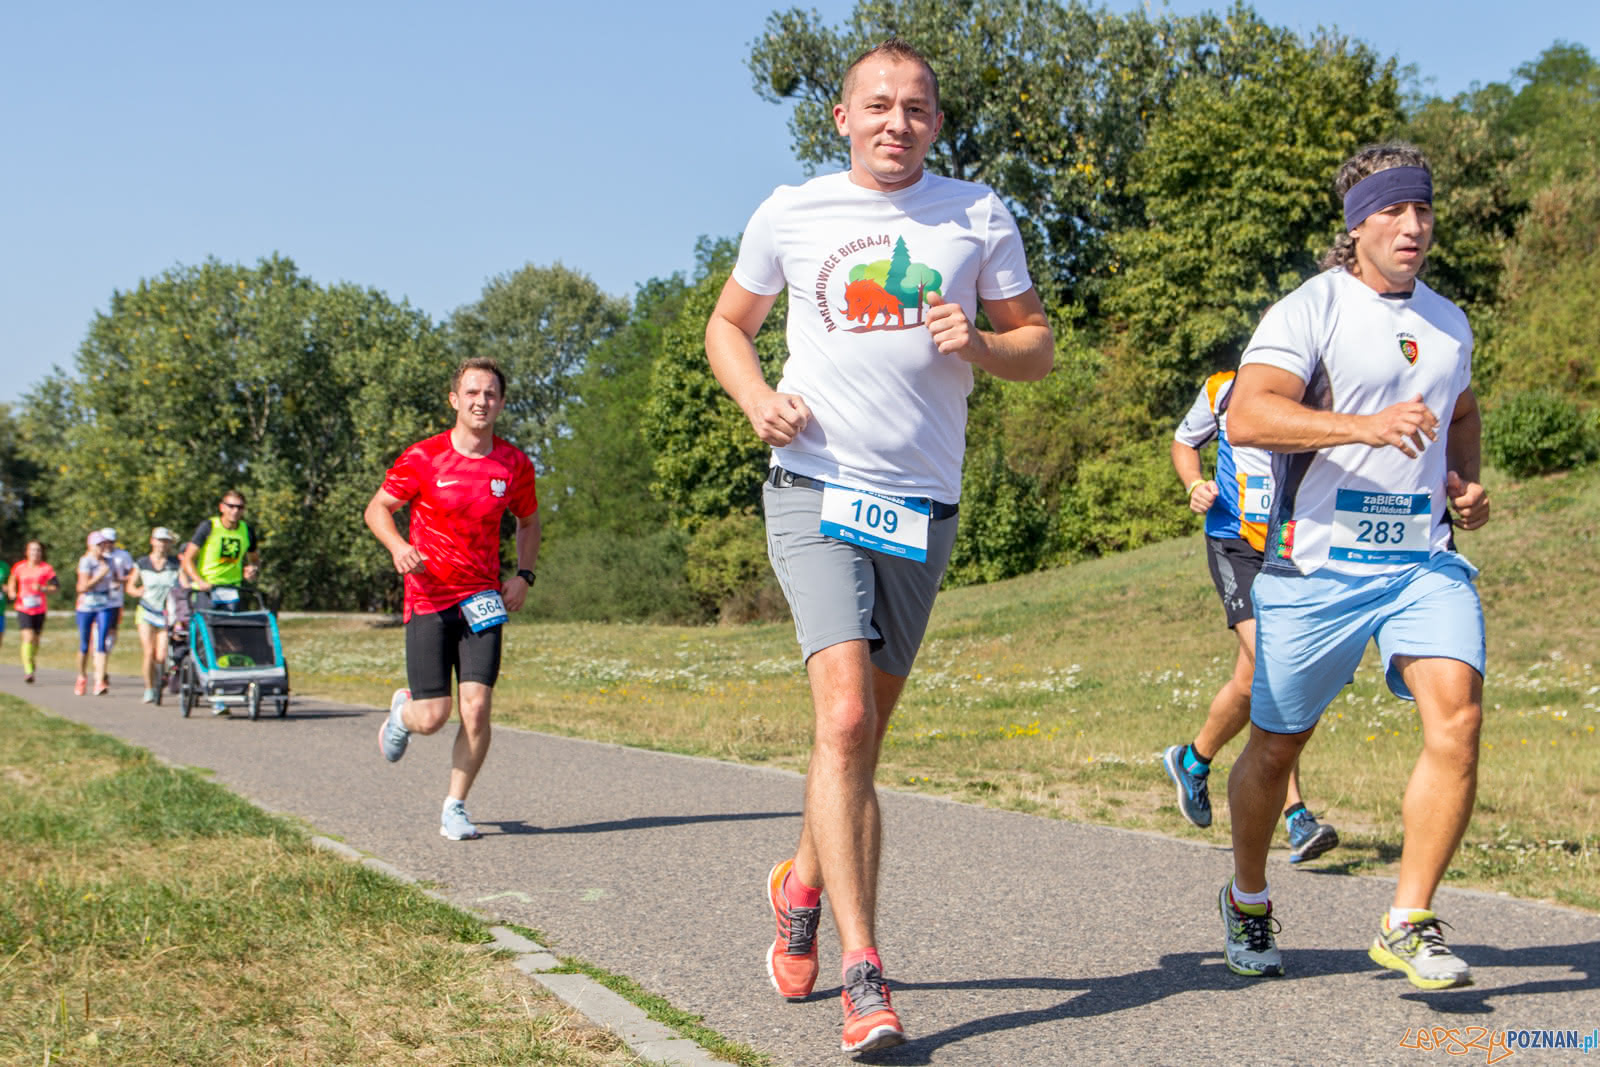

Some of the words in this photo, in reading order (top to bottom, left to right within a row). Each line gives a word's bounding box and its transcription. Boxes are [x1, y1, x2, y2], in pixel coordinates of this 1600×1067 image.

[816, 254, 841, 333] NARAMOWICE
[838, 234, 892, 258] BIEGAJĄ
[1363, 495, 1412, 507] zaBIEGaj
[851, 499, 898, 534] 109
[1355, 520, 1405, 544] 283
[477, 600, 501, 616] 564
